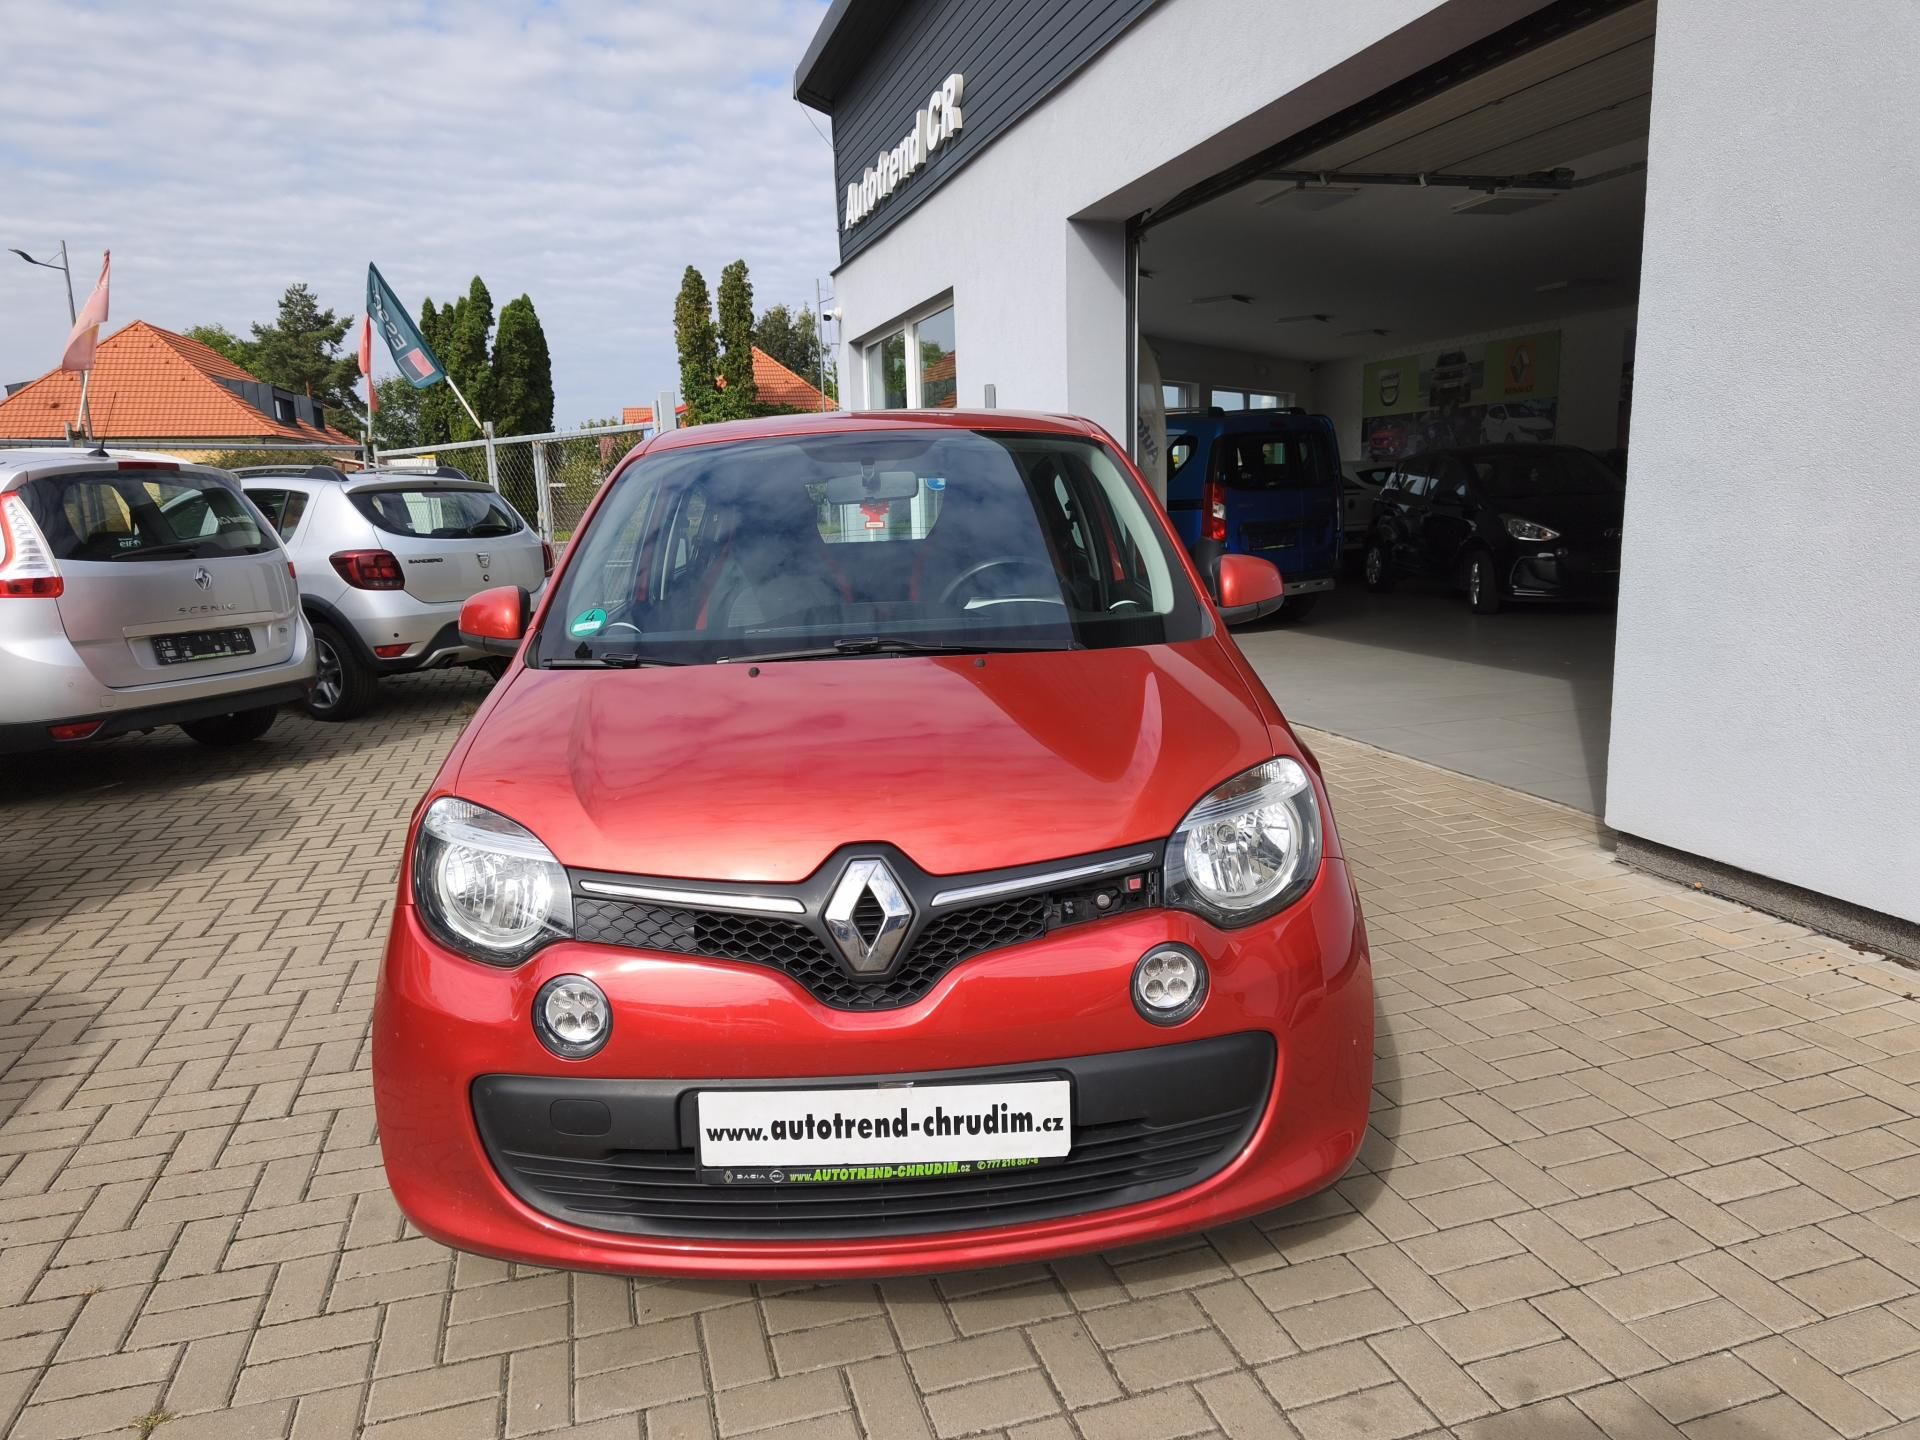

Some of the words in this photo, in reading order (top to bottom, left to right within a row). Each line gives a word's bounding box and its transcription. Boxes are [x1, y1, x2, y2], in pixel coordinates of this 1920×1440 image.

[845, 109, 928, 230] Autotrend
[927, 73, 963, 150] CR
[178, 603, 236, 614] SCENIC
[585, 609, 595, 622] 4
[706, 1102, 1064, 1141] www.autotrend-chrudim.cz
[790, 1161, 970, 1182] www.AUTOTREND-CHRUDIM.cz
